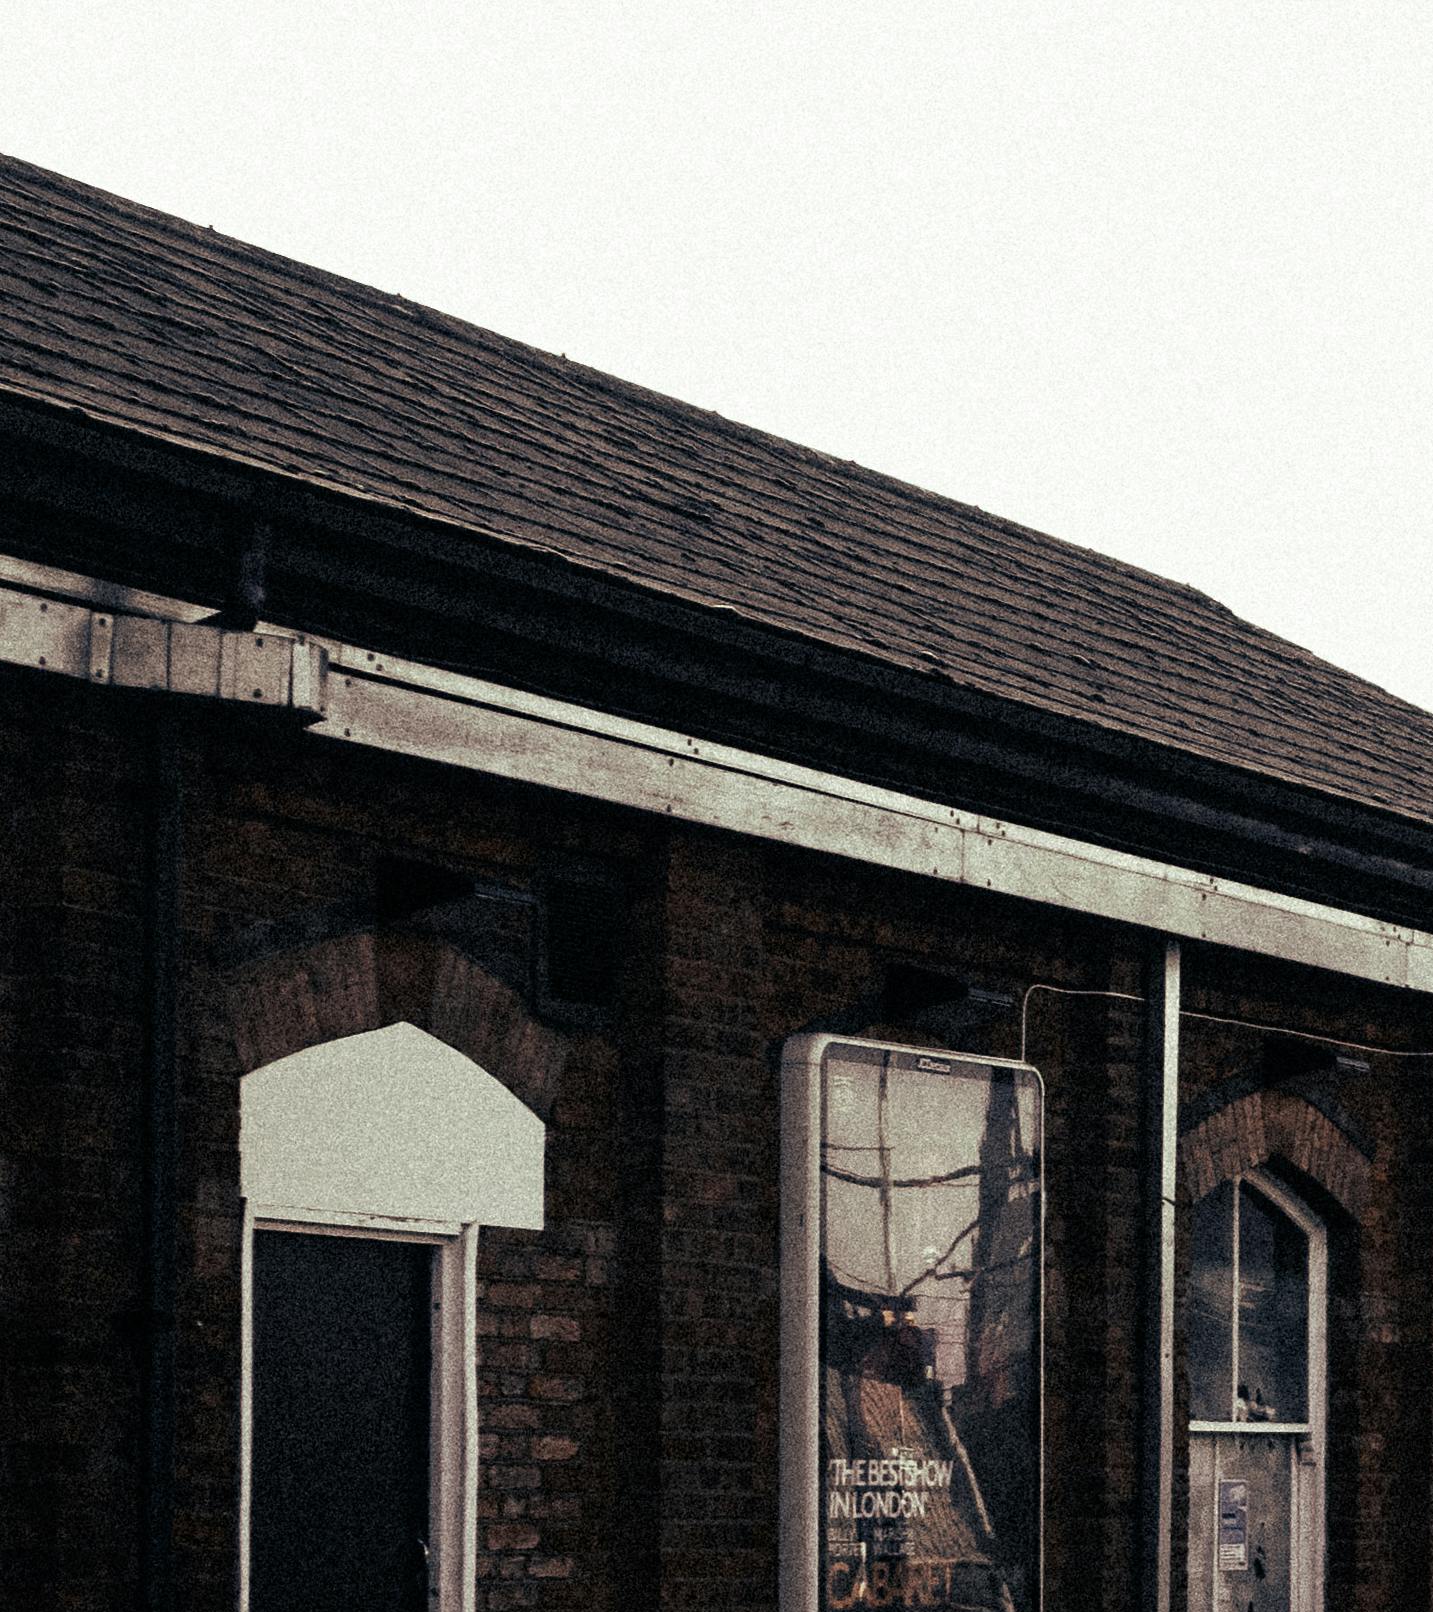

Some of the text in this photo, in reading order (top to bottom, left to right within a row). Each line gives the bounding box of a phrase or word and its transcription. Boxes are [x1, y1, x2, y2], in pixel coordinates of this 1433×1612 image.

[868, 1457, 906, 1487] BEST
[905, 1458, 954, 1488] SHOW
[829, 1490, 850, 1519] IN
